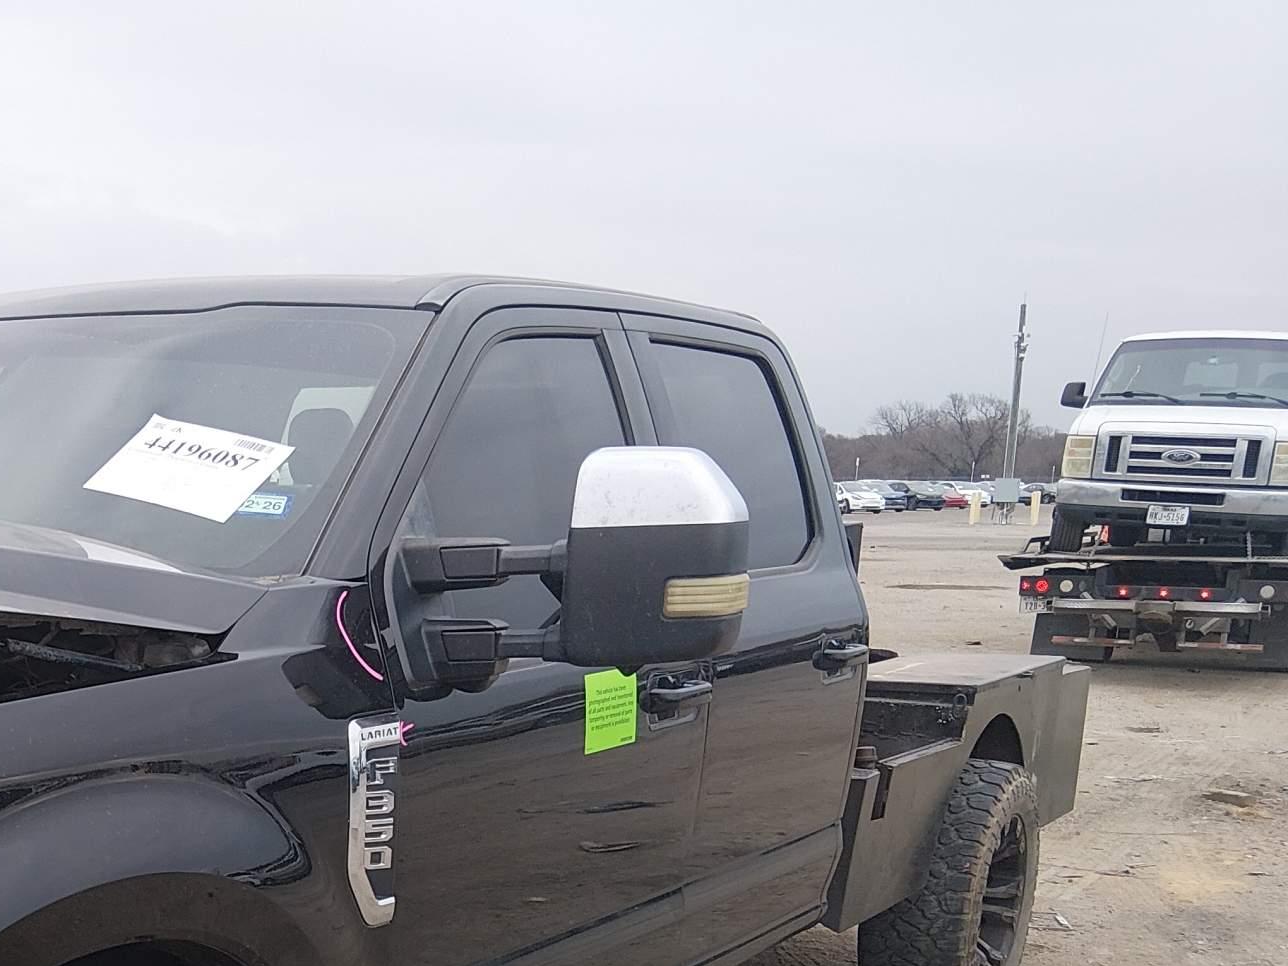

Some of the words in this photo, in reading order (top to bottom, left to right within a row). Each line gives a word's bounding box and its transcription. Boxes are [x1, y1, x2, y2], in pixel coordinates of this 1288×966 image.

[144, 436, 260, 470] 44196087
[262, 501, 283, 511] 26
[361, 726, 399, 741] LARIAT
